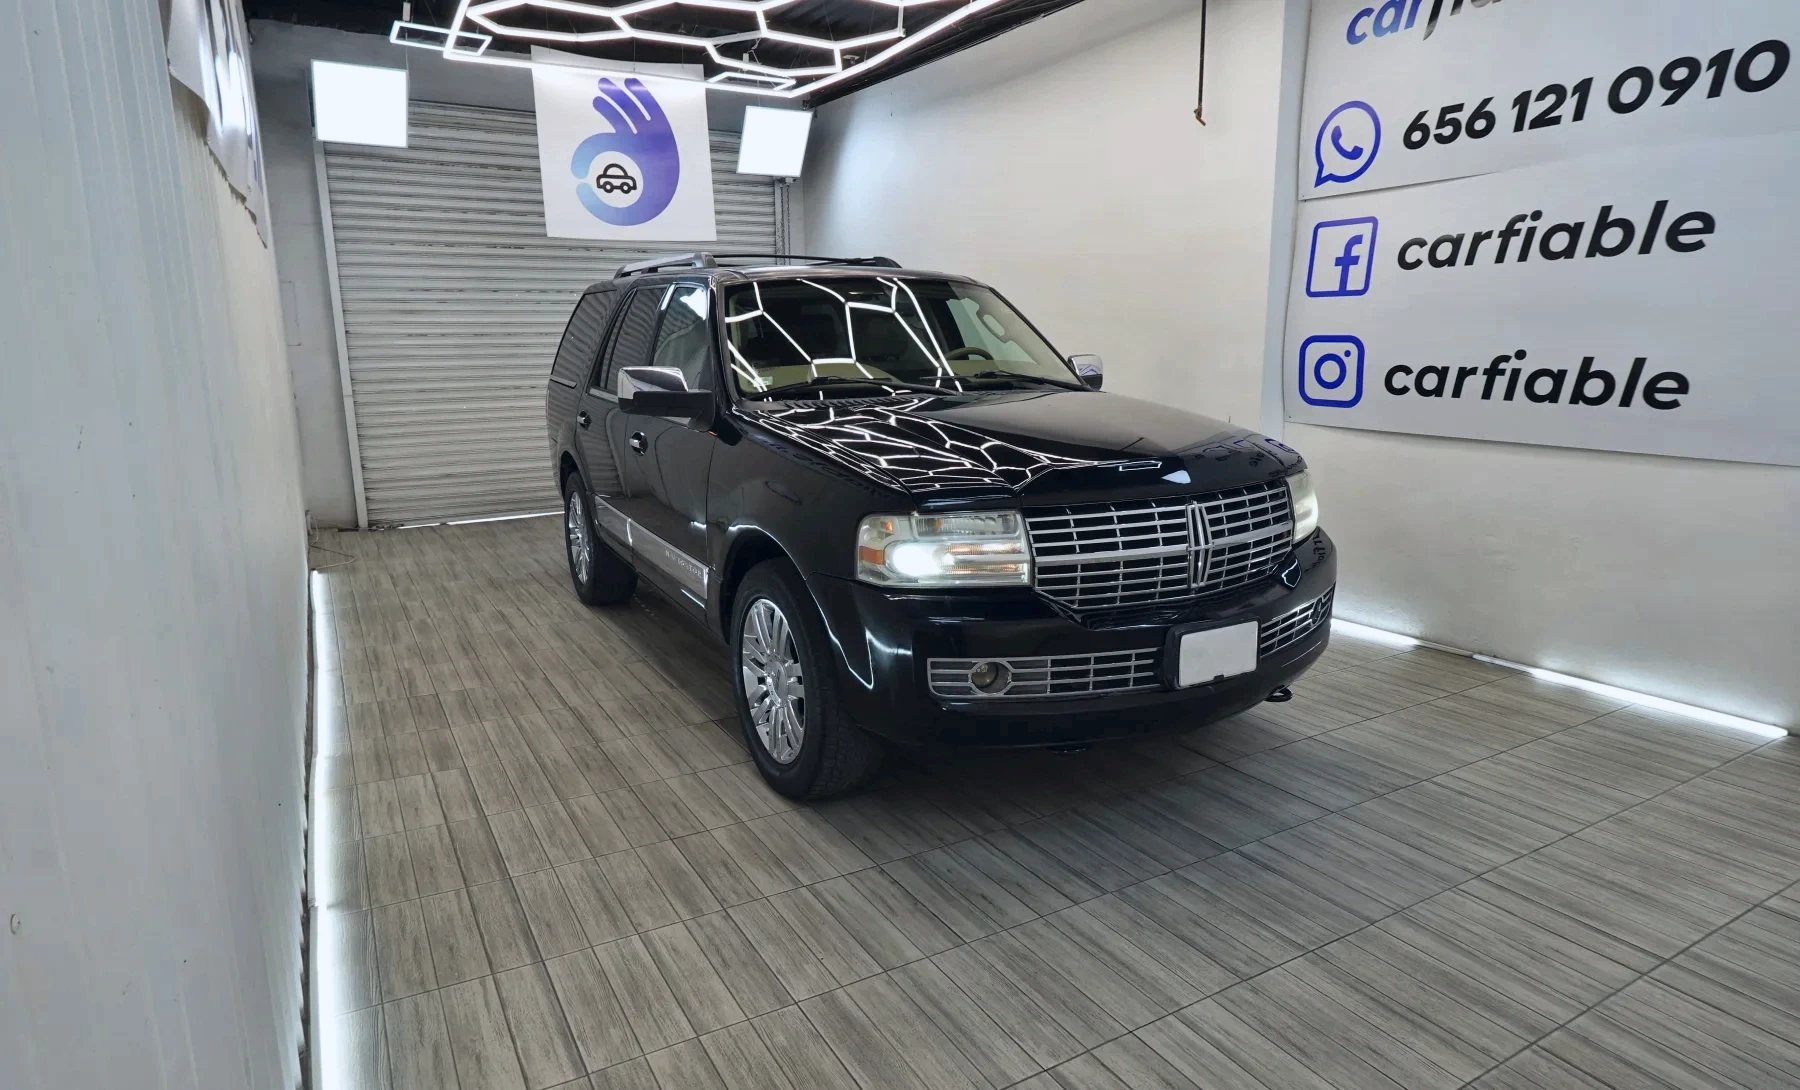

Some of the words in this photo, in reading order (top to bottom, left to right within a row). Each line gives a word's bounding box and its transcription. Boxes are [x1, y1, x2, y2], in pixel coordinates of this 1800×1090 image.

[1402, 97, 1496, 151] 656
[1511, 77, 1594, 133] 121
[1608, 39, 1791, 115] 0910
[1397, 200, 1716, 271] carfiable
[1384, 349, 1690, 411] carfiable
